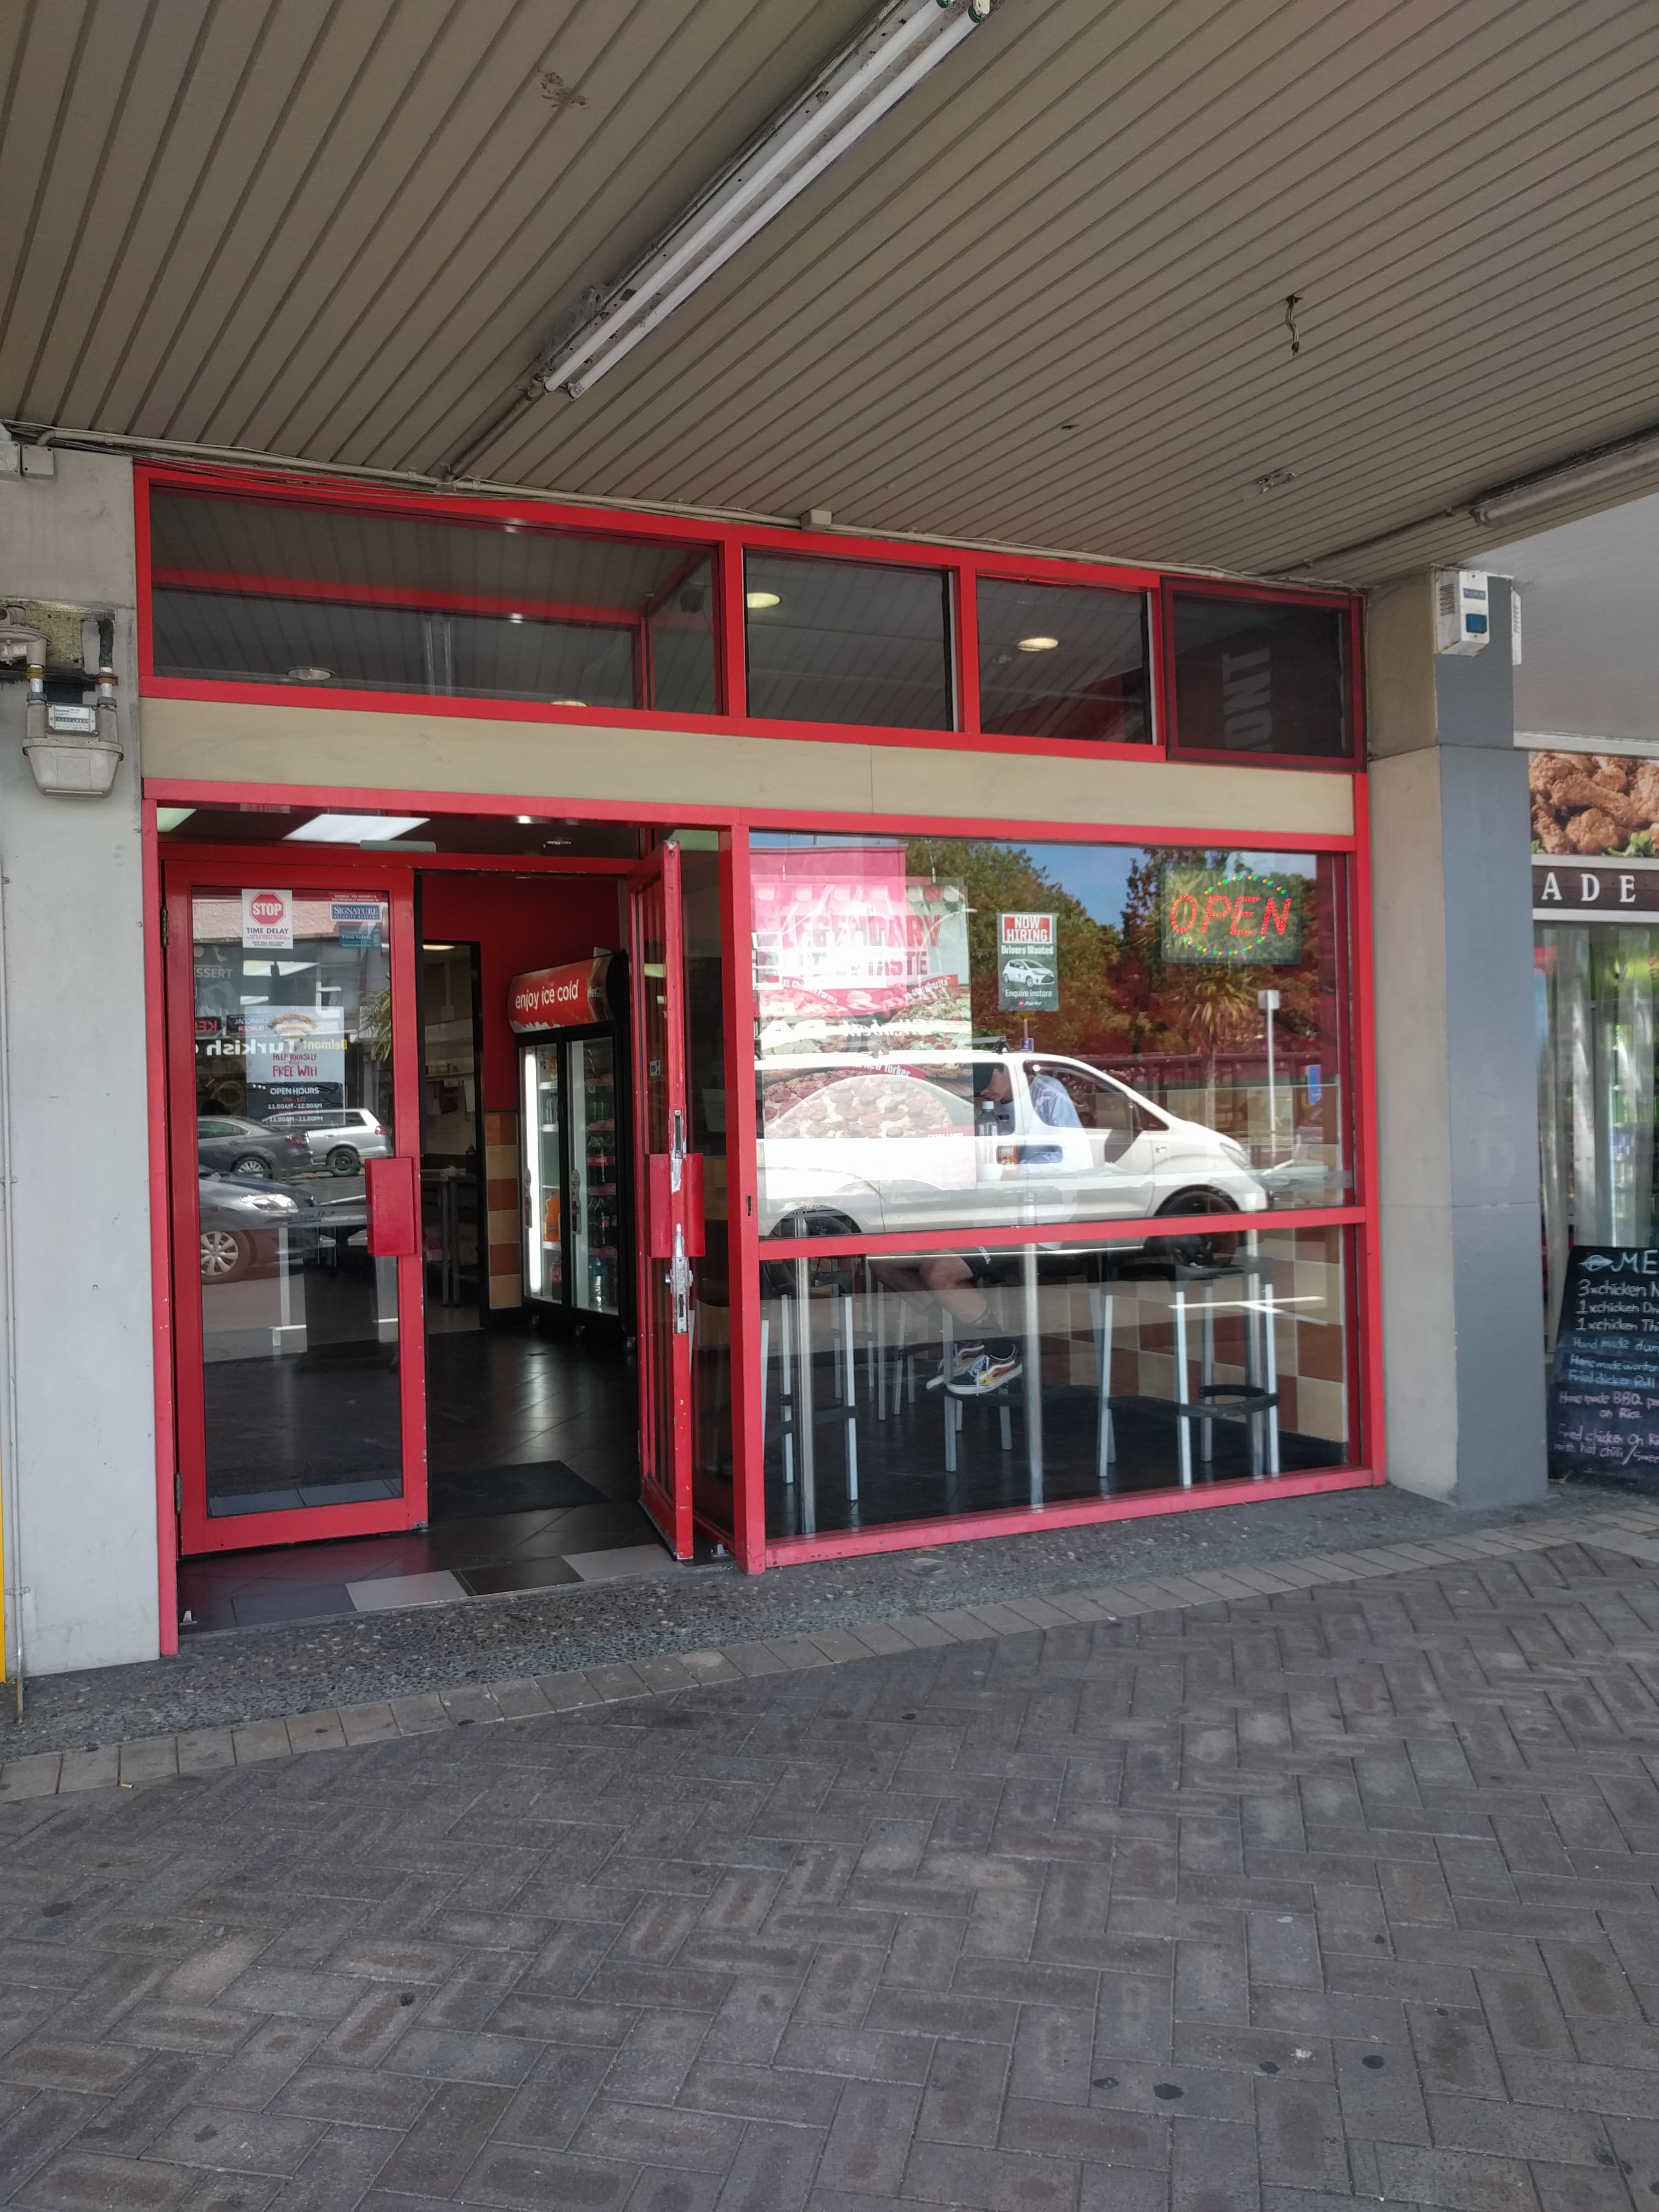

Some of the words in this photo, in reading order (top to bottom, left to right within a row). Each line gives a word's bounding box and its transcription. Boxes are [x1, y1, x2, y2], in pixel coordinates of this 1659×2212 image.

[1221, 647, 1273, 752] ONT
[252, 902, 282, 916] STOP
[1169, 894, 1291, 936] OPEN
[1015, 916, 1040, 929] NOW
[1007, 928, 1048, 942] HIRING
[1001, 945, 1026, 955] Drivers
[1027, 945, 1054, 955] Wanted
[515, 989, 539, 1012] enjoy
[541, 986, 555, 1007] ice
[557, 979, 579, 1002] cold
[1005, 989, 1029, 998] Enquire
[273, 1065, 295, 1077] FREE
[884, 1064, 911, 1077] Yorker
[1612, 1391, 1644, 1406] BBQ
